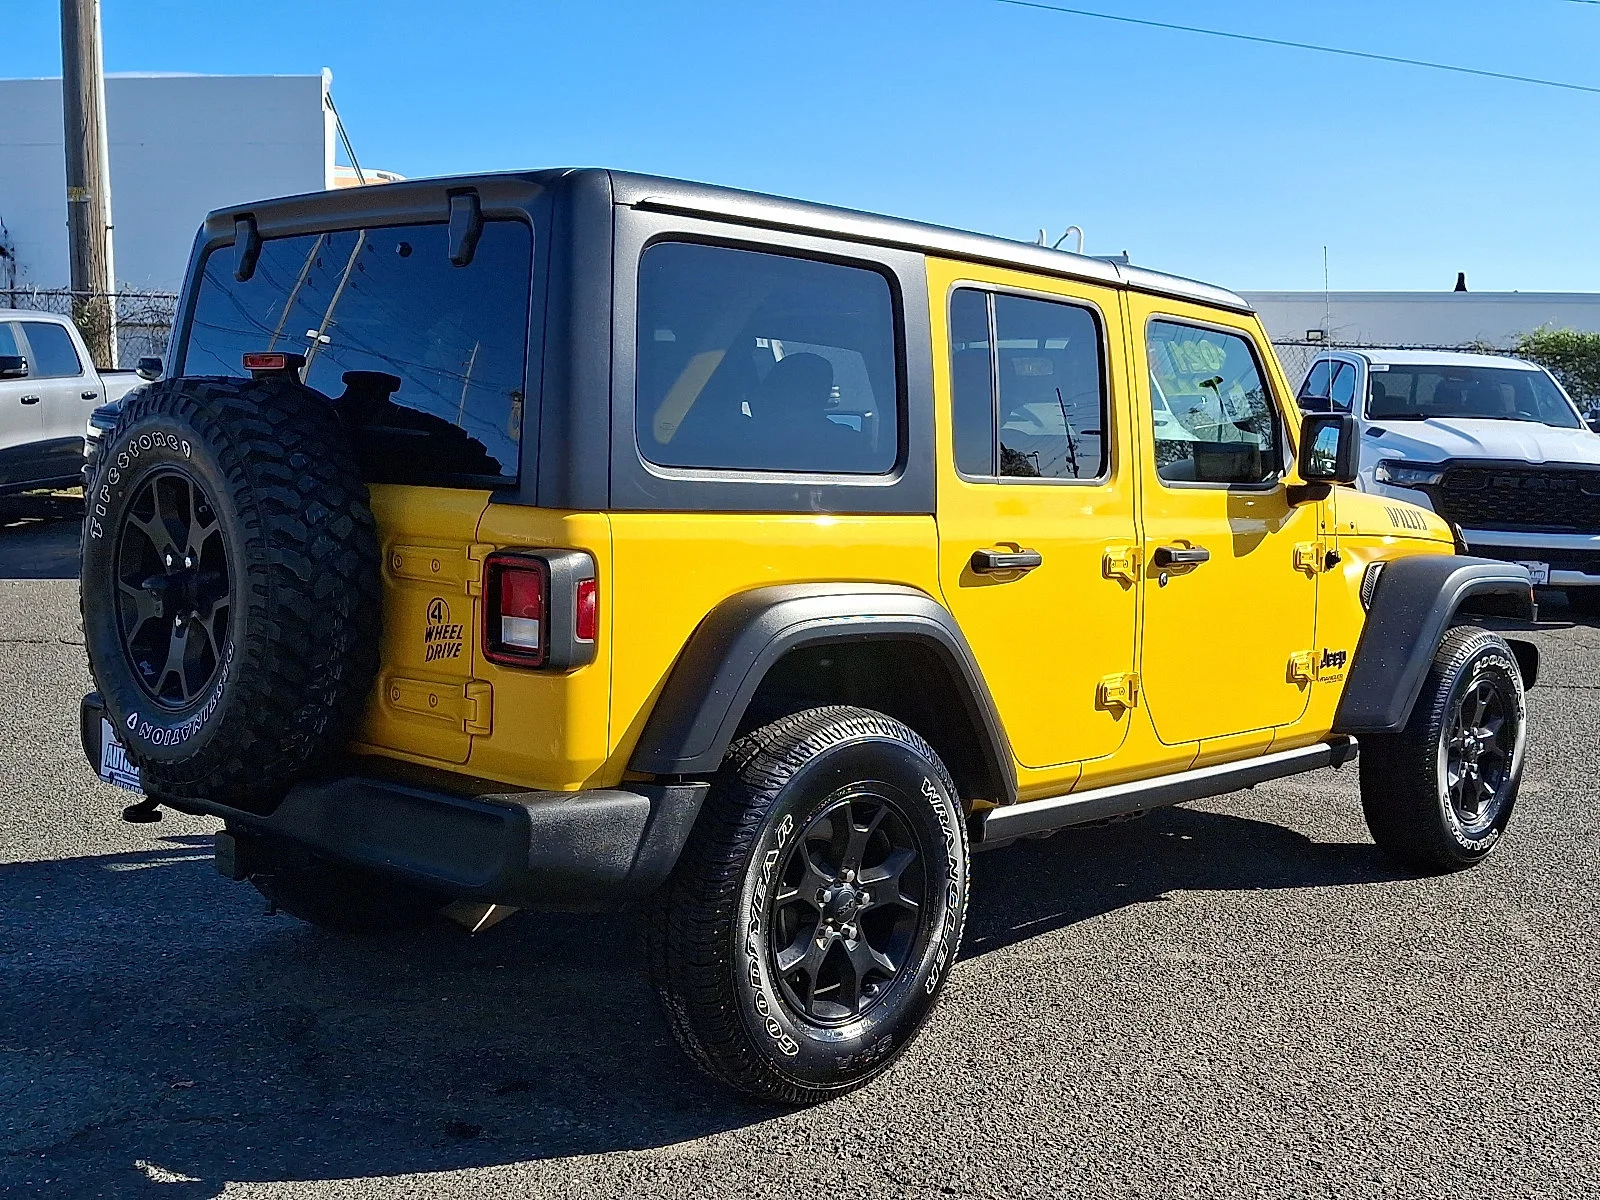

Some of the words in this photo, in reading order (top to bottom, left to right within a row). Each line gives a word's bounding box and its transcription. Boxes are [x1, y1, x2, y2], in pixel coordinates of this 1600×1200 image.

[90, 431, 179, 539] Firestone
[1383, 506, 1428, 531] WILLYS
[424, 624, 464, 644] WHEEL
[430, 601, 443, 624] 4
[424, 641, 463, 663] DRIVE
[1319, 647, 1347, 670] Jeep
[138, 640, 235, 746] DESTINATION
[1472, 654, 1525, 721] GOODYEAR
[920, 776, 960, 995] WRANGLER
[744, 813, 800, 1057] GOODYEAR
